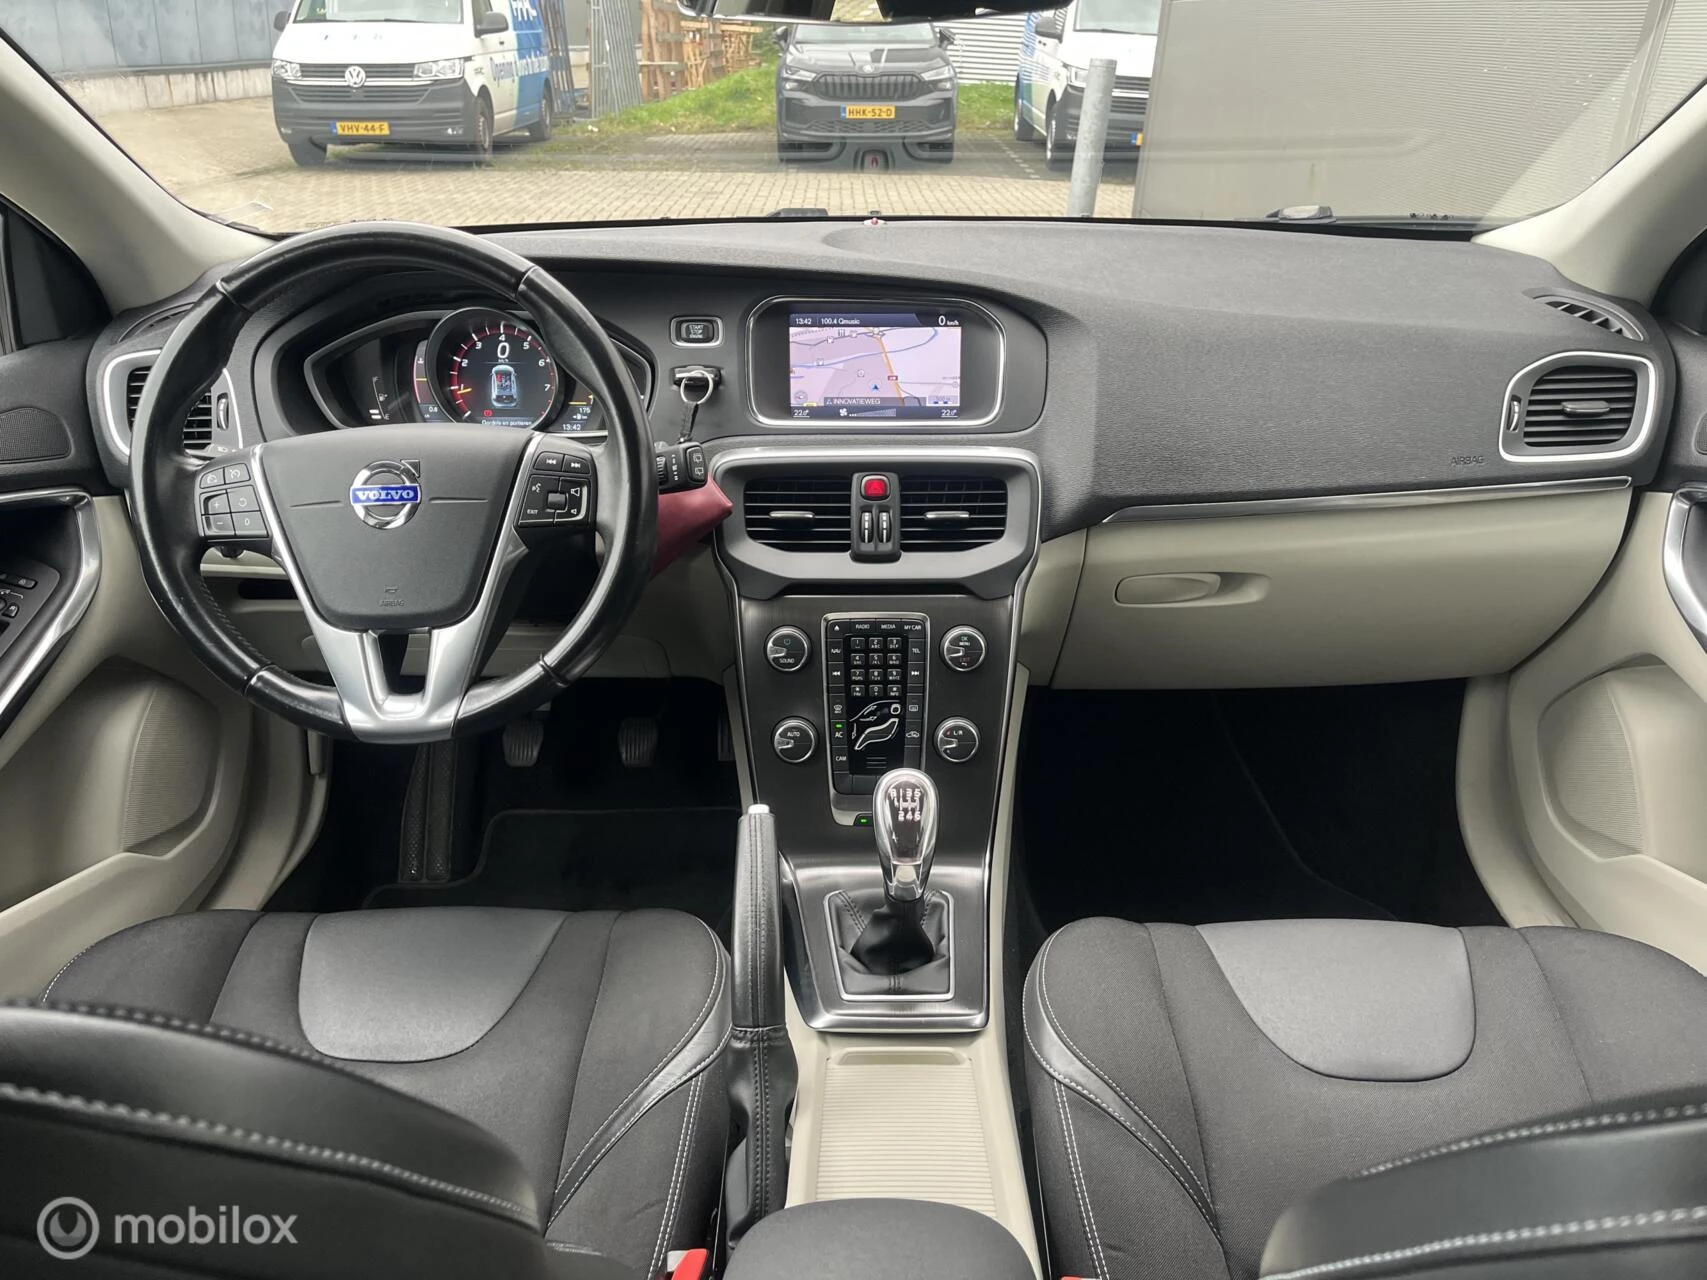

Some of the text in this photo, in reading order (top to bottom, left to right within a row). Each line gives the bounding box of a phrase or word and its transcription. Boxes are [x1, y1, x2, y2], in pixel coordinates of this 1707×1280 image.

[848, 107, 893, 118] HHK-52-D
[338, 124, 386, 134] VHV-44-F
[938, 315, 946, 326] 0
[497, 342, 510, 358] 0
[355, 490, 414, 500] VOLVO
[898, 811, 921, 821] 2 4 6
